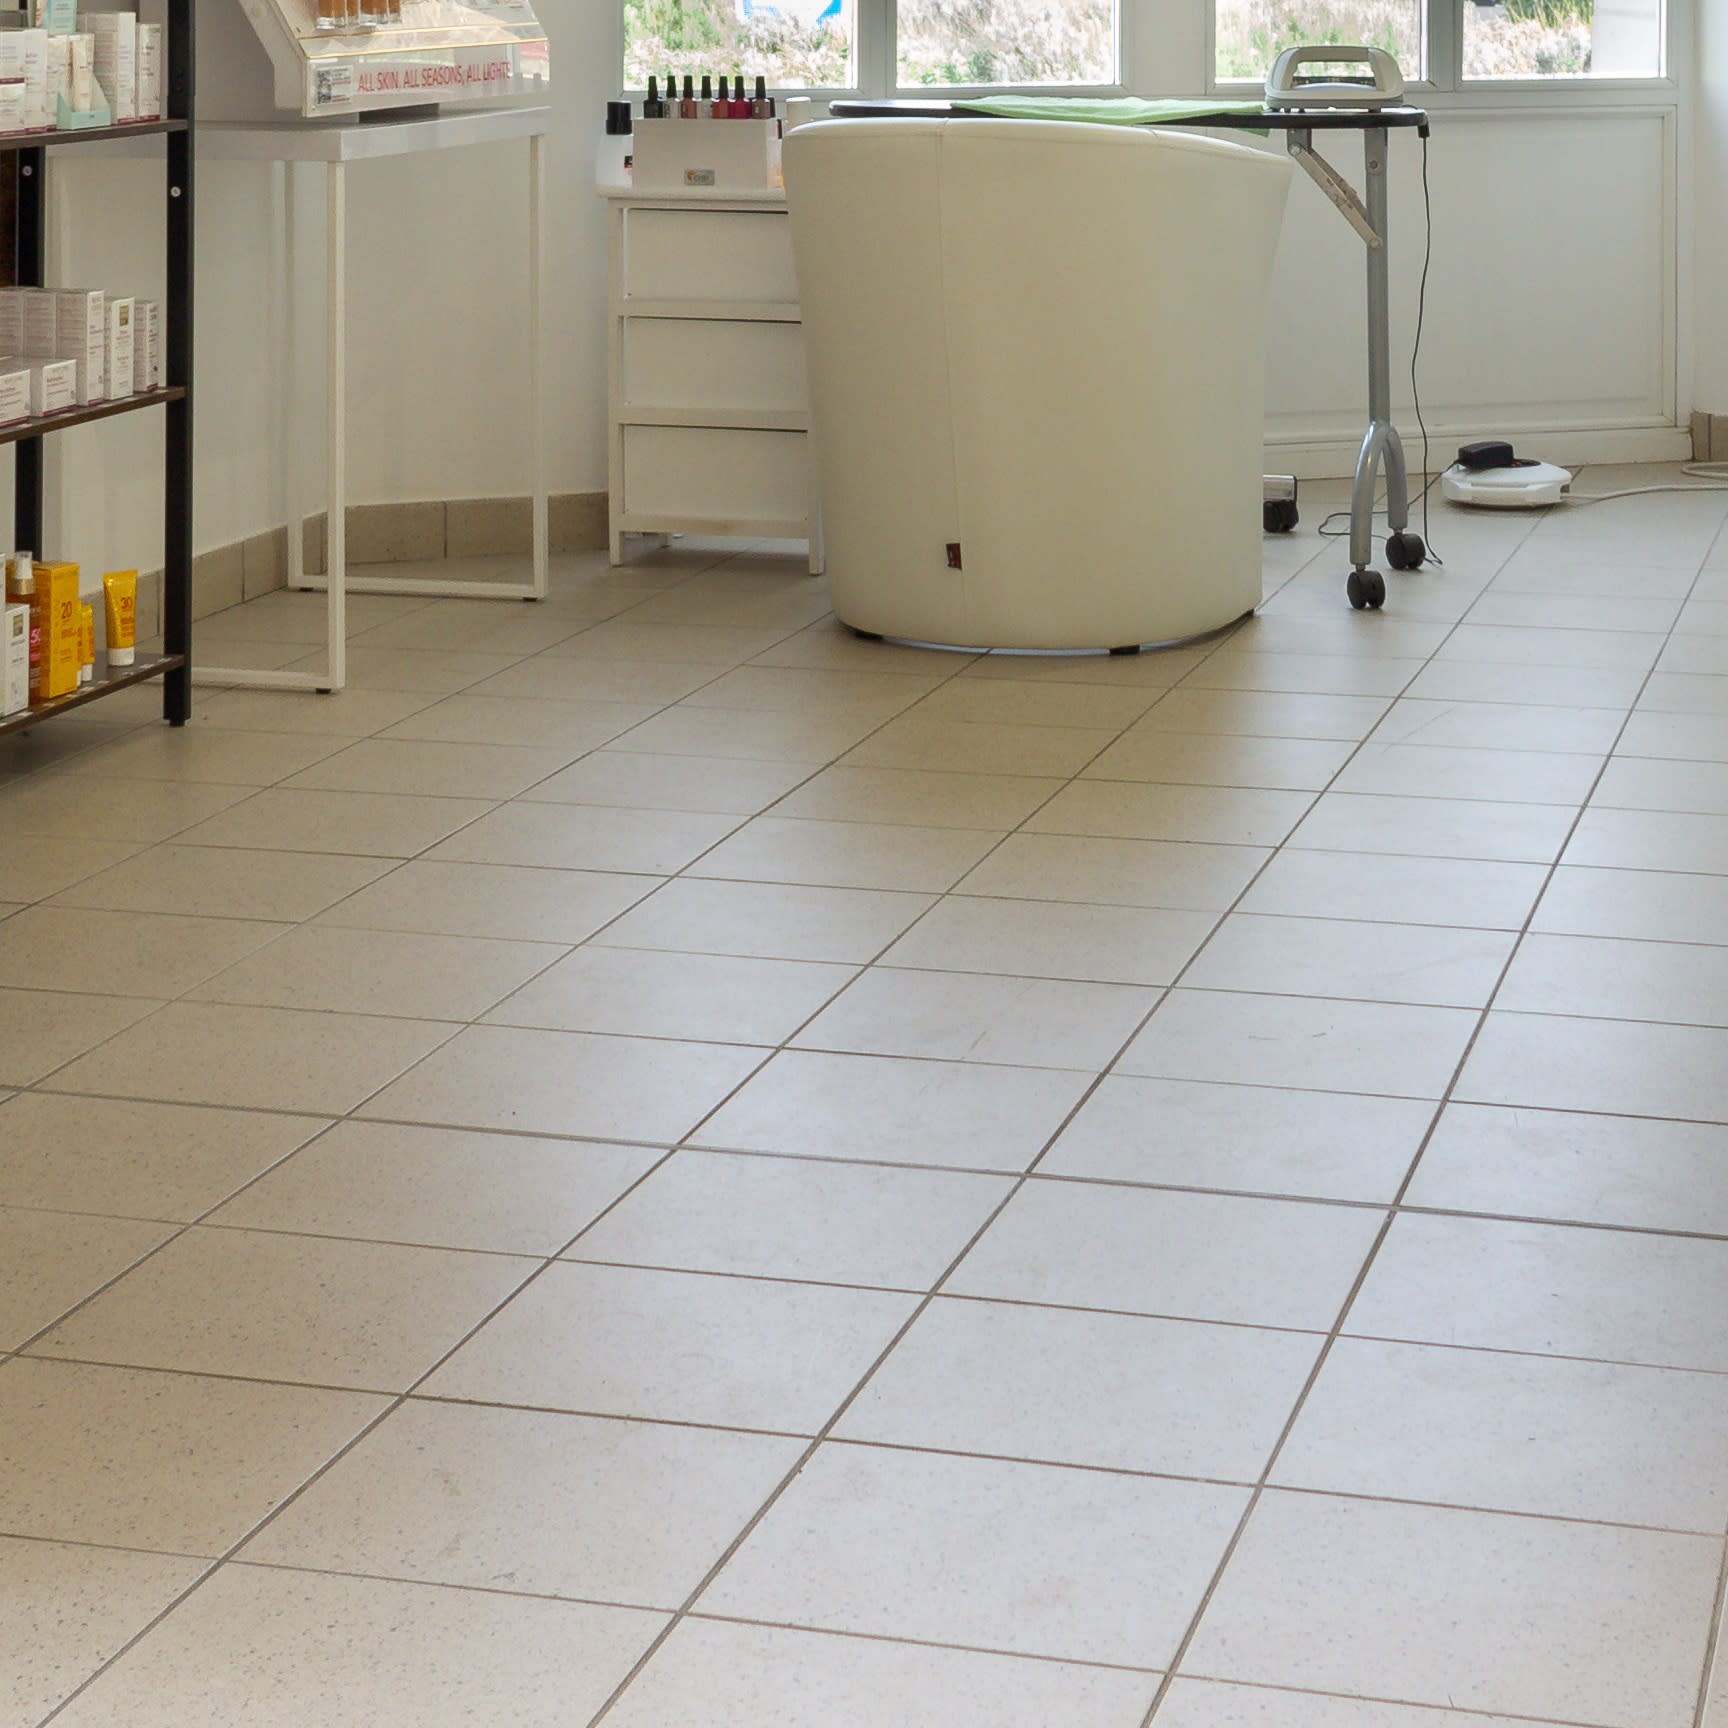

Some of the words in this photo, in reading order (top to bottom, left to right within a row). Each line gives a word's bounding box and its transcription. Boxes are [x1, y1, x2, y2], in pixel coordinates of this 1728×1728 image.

[358, 72, 375, 92] ALL
[403, 69, 420, 89] ALL
[466, 64, 482, 82] ALL
[61, 600, 72, 620] 20
[120, 596, 133, 610] 30
